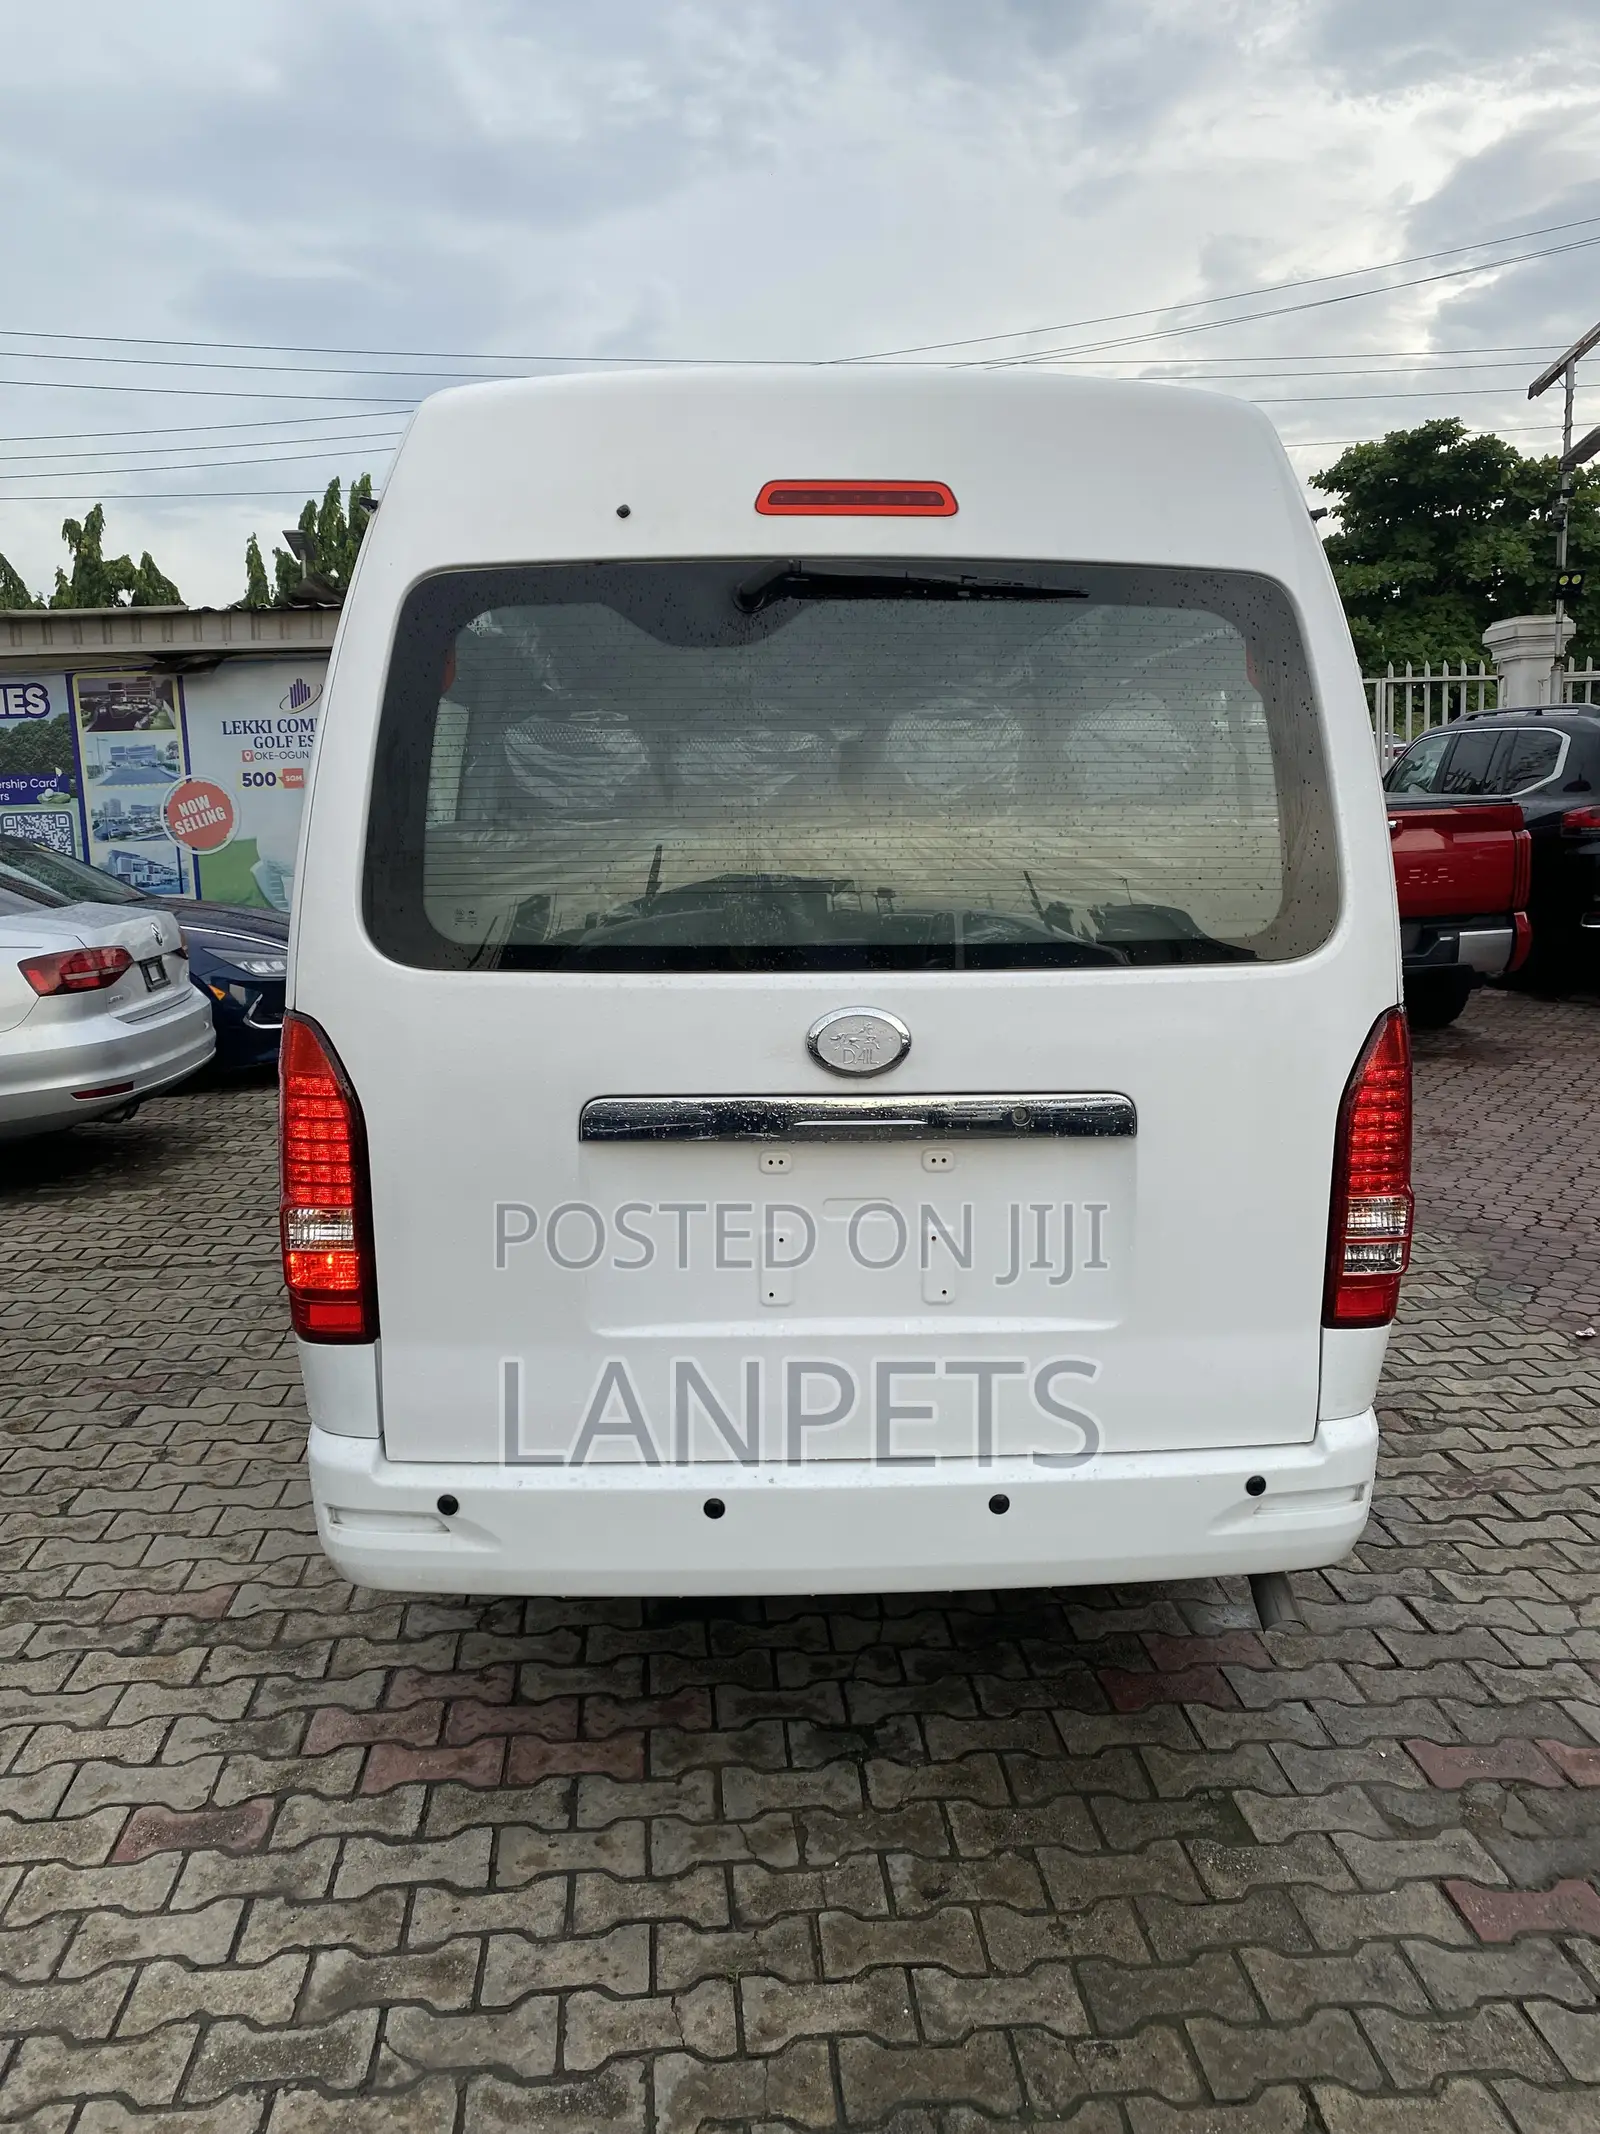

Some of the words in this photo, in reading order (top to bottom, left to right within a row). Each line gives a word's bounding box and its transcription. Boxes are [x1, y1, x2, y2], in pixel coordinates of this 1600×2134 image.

[221, 719, 273, 735] LEKKI
[253, 736, 294, 749] GOLF
[254, 751, 309, 760] OKE-OGUN
[30, 778, 57, 788] Card
[242, 771, 277, 787] 500
[178, 794, 210, 817] NOW
[174, 806, 226, 835] SELLING
